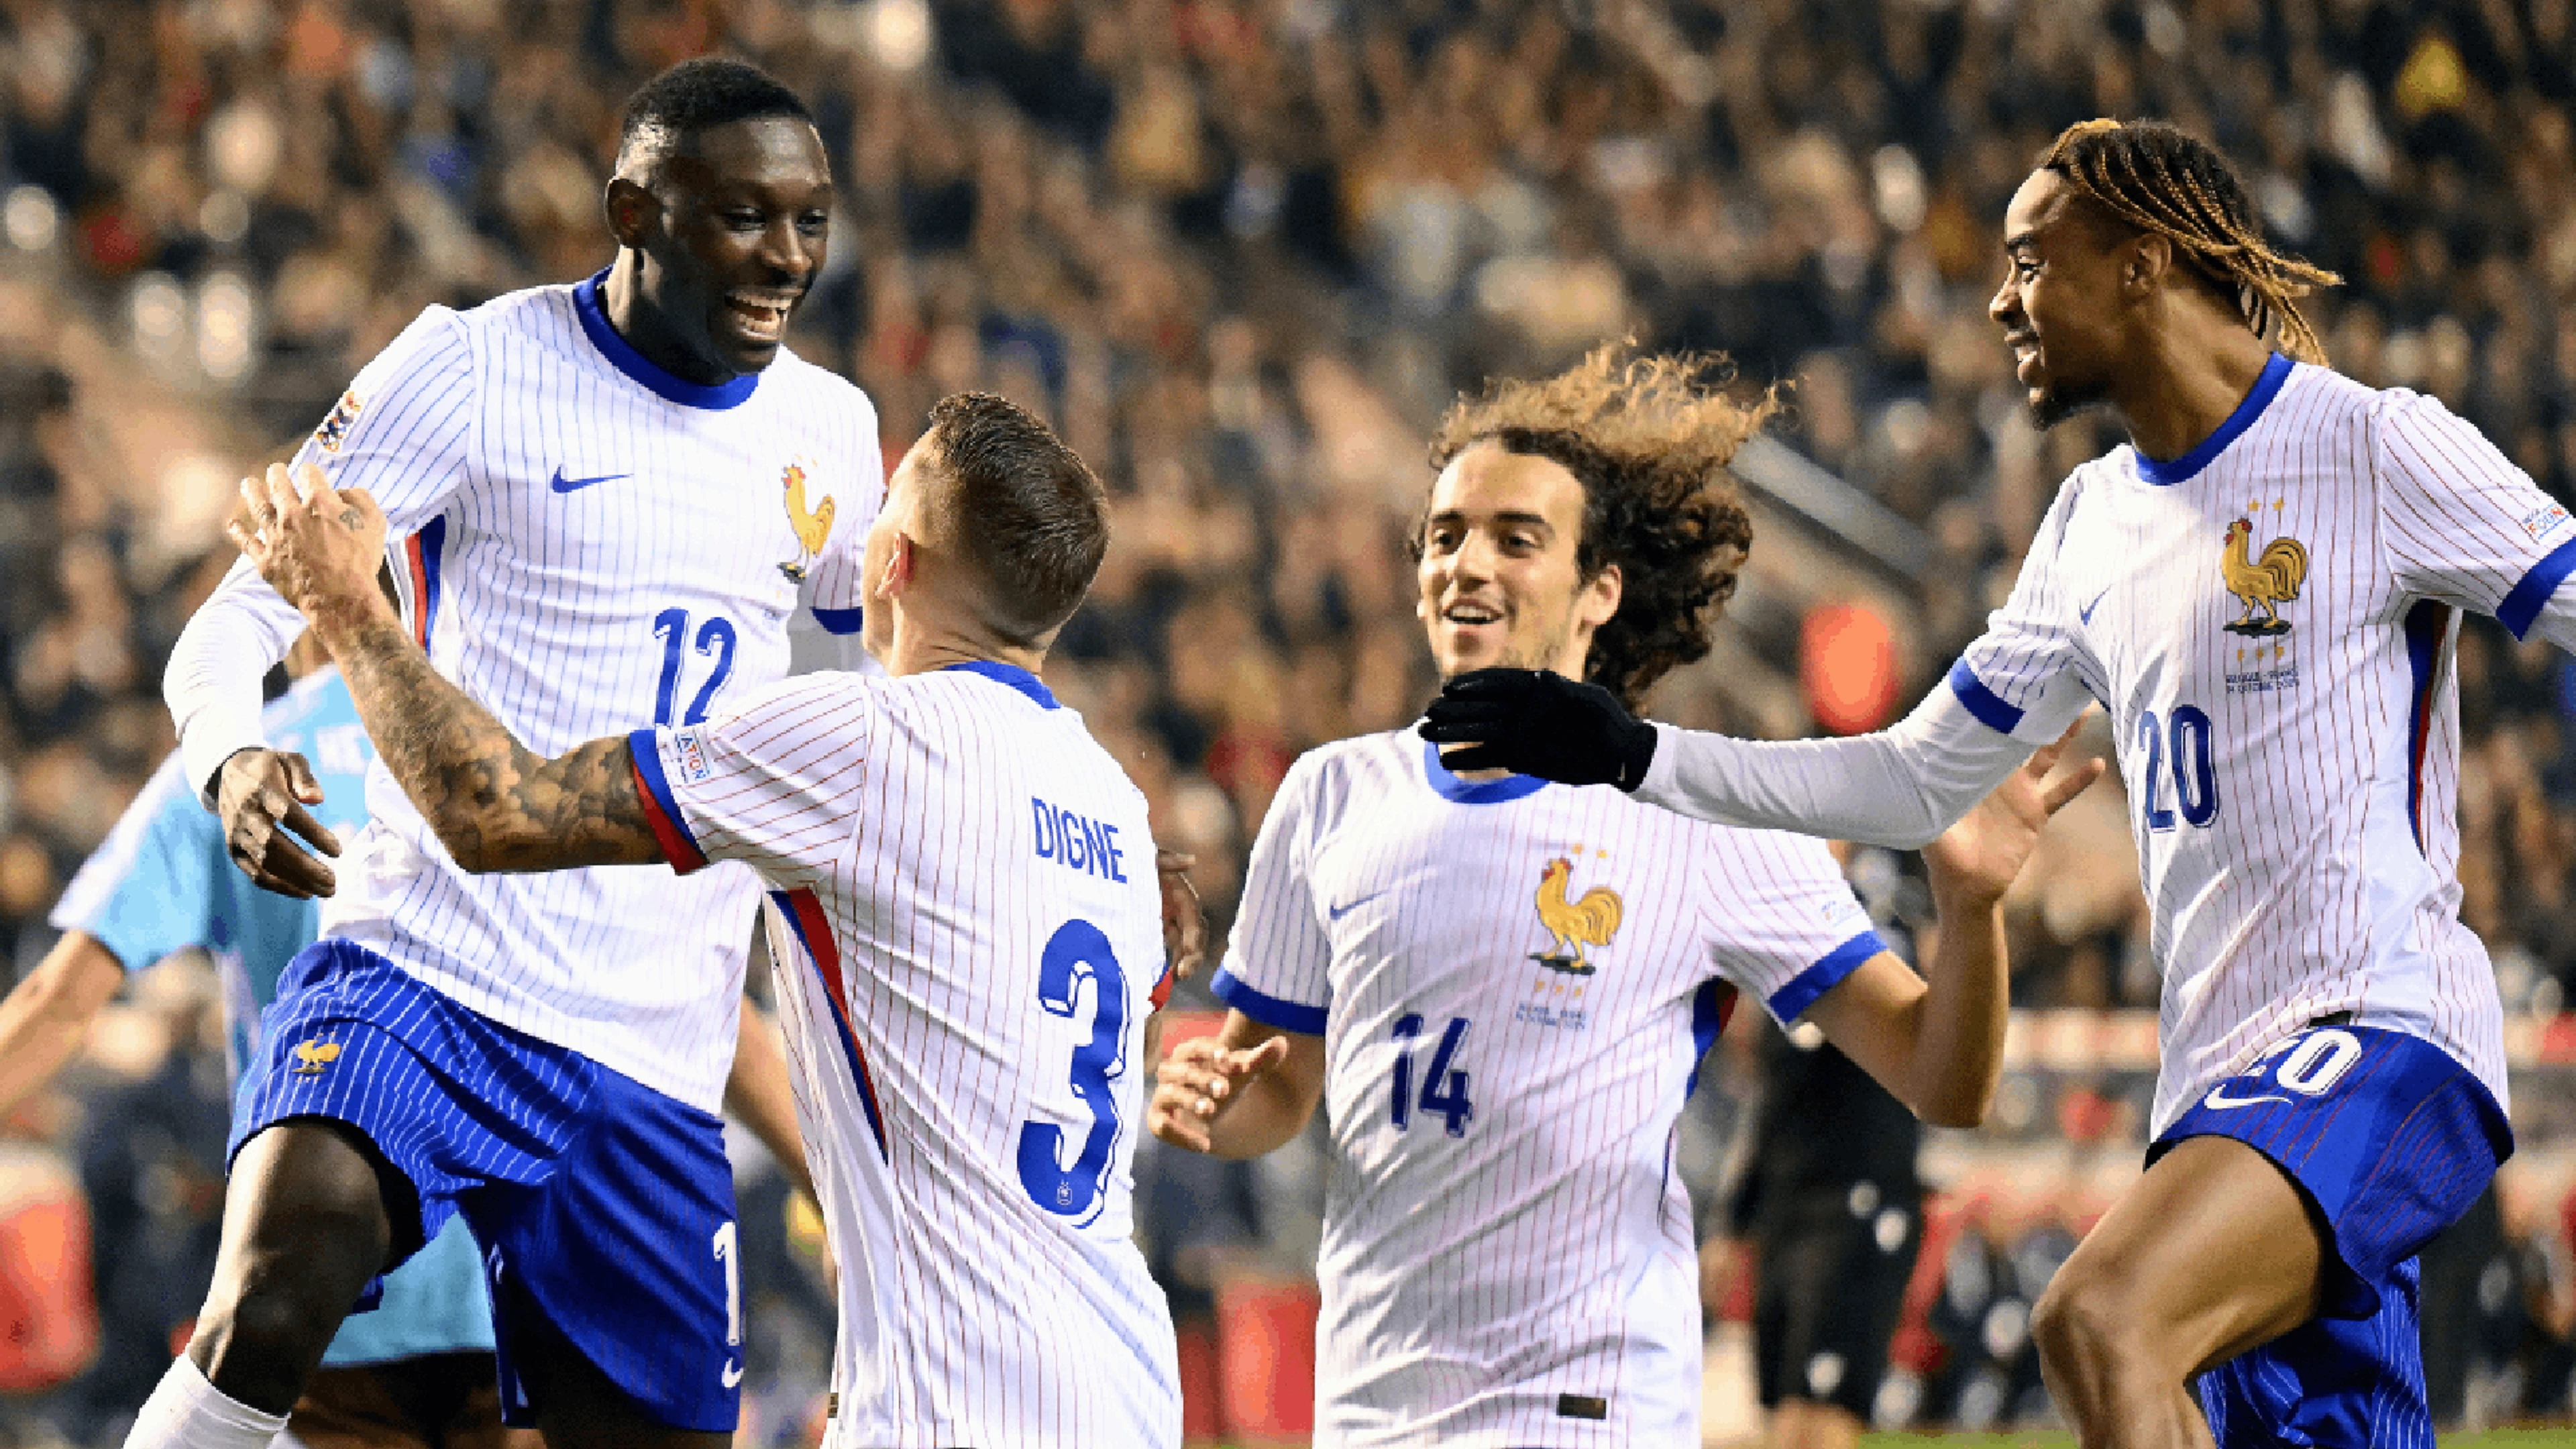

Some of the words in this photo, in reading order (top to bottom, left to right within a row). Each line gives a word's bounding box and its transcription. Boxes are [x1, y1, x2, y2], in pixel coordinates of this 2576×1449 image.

[652, 606, 737, 730] 12
[2138, 704, 2220, 833] 20
[1031, 796, 1128, 885] DIGNE
[1017, 918, 1131, 1229] 3
[1391, 1012, 1473, 1138] 14
[713, 1220, 740, 1346] 1
